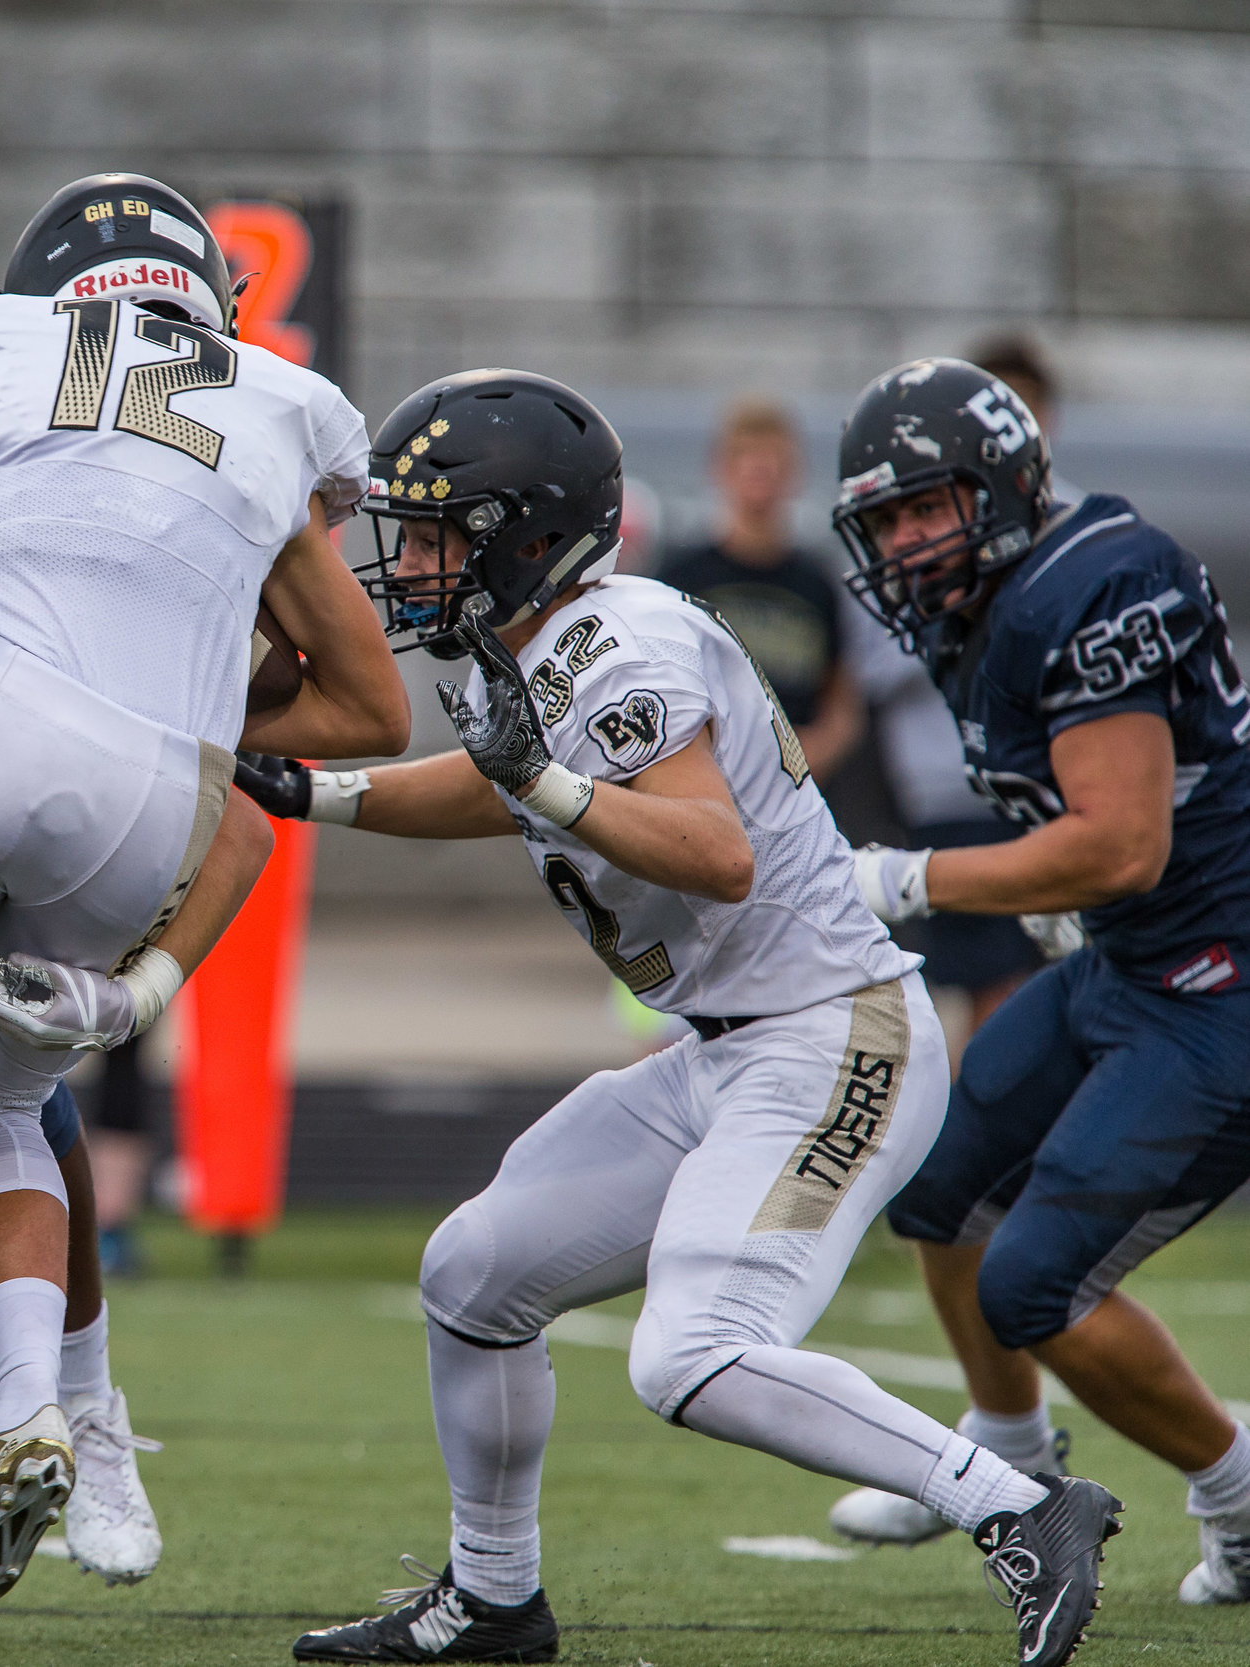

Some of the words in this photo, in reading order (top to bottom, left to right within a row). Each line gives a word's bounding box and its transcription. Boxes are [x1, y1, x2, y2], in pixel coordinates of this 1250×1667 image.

[84, 202, 115, 222] GH
[122, 199, 150, 216] ED
[50, 297, 238, 471] 12
[527, 614, 620, 729] 32
[1072, 600, 1177, 699] 53
[796, 1050, 895, 1191] TIGERS
